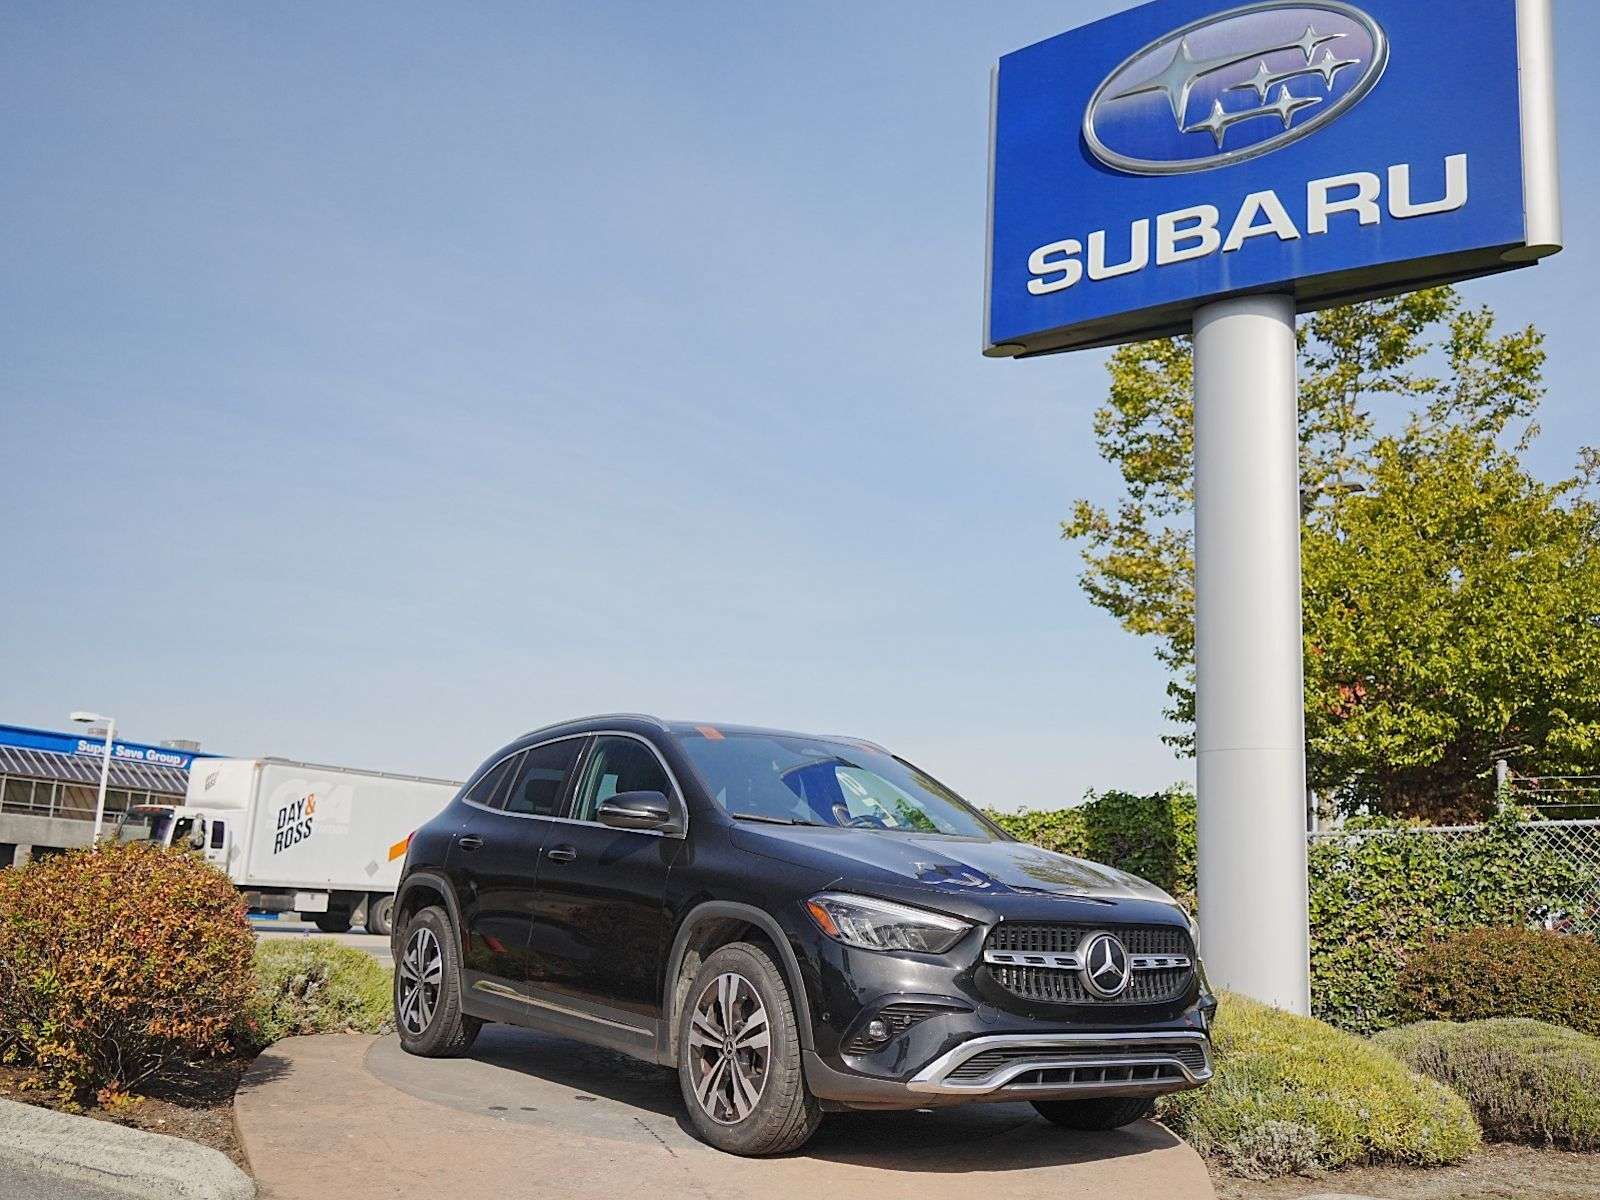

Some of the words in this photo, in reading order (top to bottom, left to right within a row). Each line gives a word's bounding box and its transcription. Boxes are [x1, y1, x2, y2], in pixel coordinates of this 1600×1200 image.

[1027, 153, 1467, 295] SUBARU
[78, 740, 114, 755] Sup
[115, 745, 143, 759] Save
[146, 750, 181, 764] Group
[274, 817, 313, 855] ROSS
